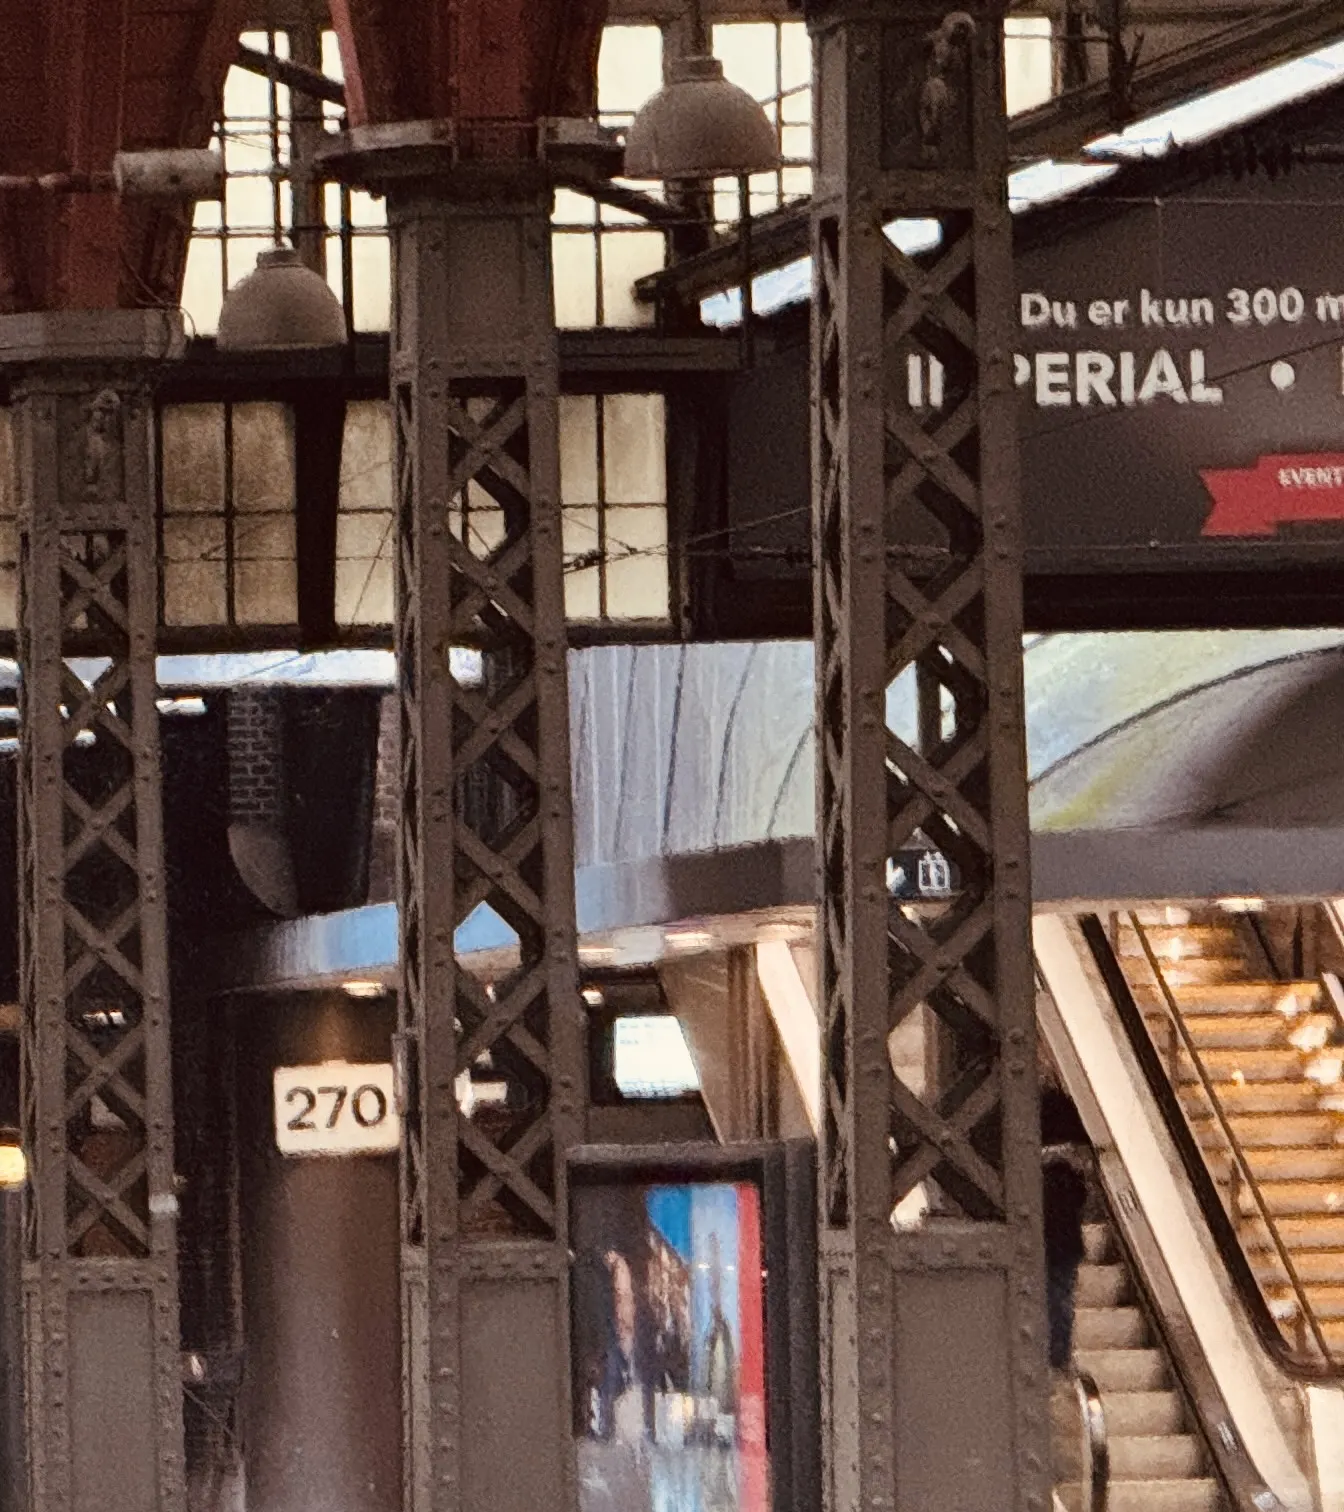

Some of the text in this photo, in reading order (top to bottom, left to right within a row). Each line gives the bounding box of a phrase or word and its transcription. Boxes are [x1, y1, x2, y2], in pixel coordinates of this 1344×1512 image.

[1020, 292, 1077, 328] Du
[1088, 299, 1130, 326] er
[1140, 288, 1214, 327] kun
[1226, 287, 1305, 325] 300
[285, 1083, 388, 1131] 270
